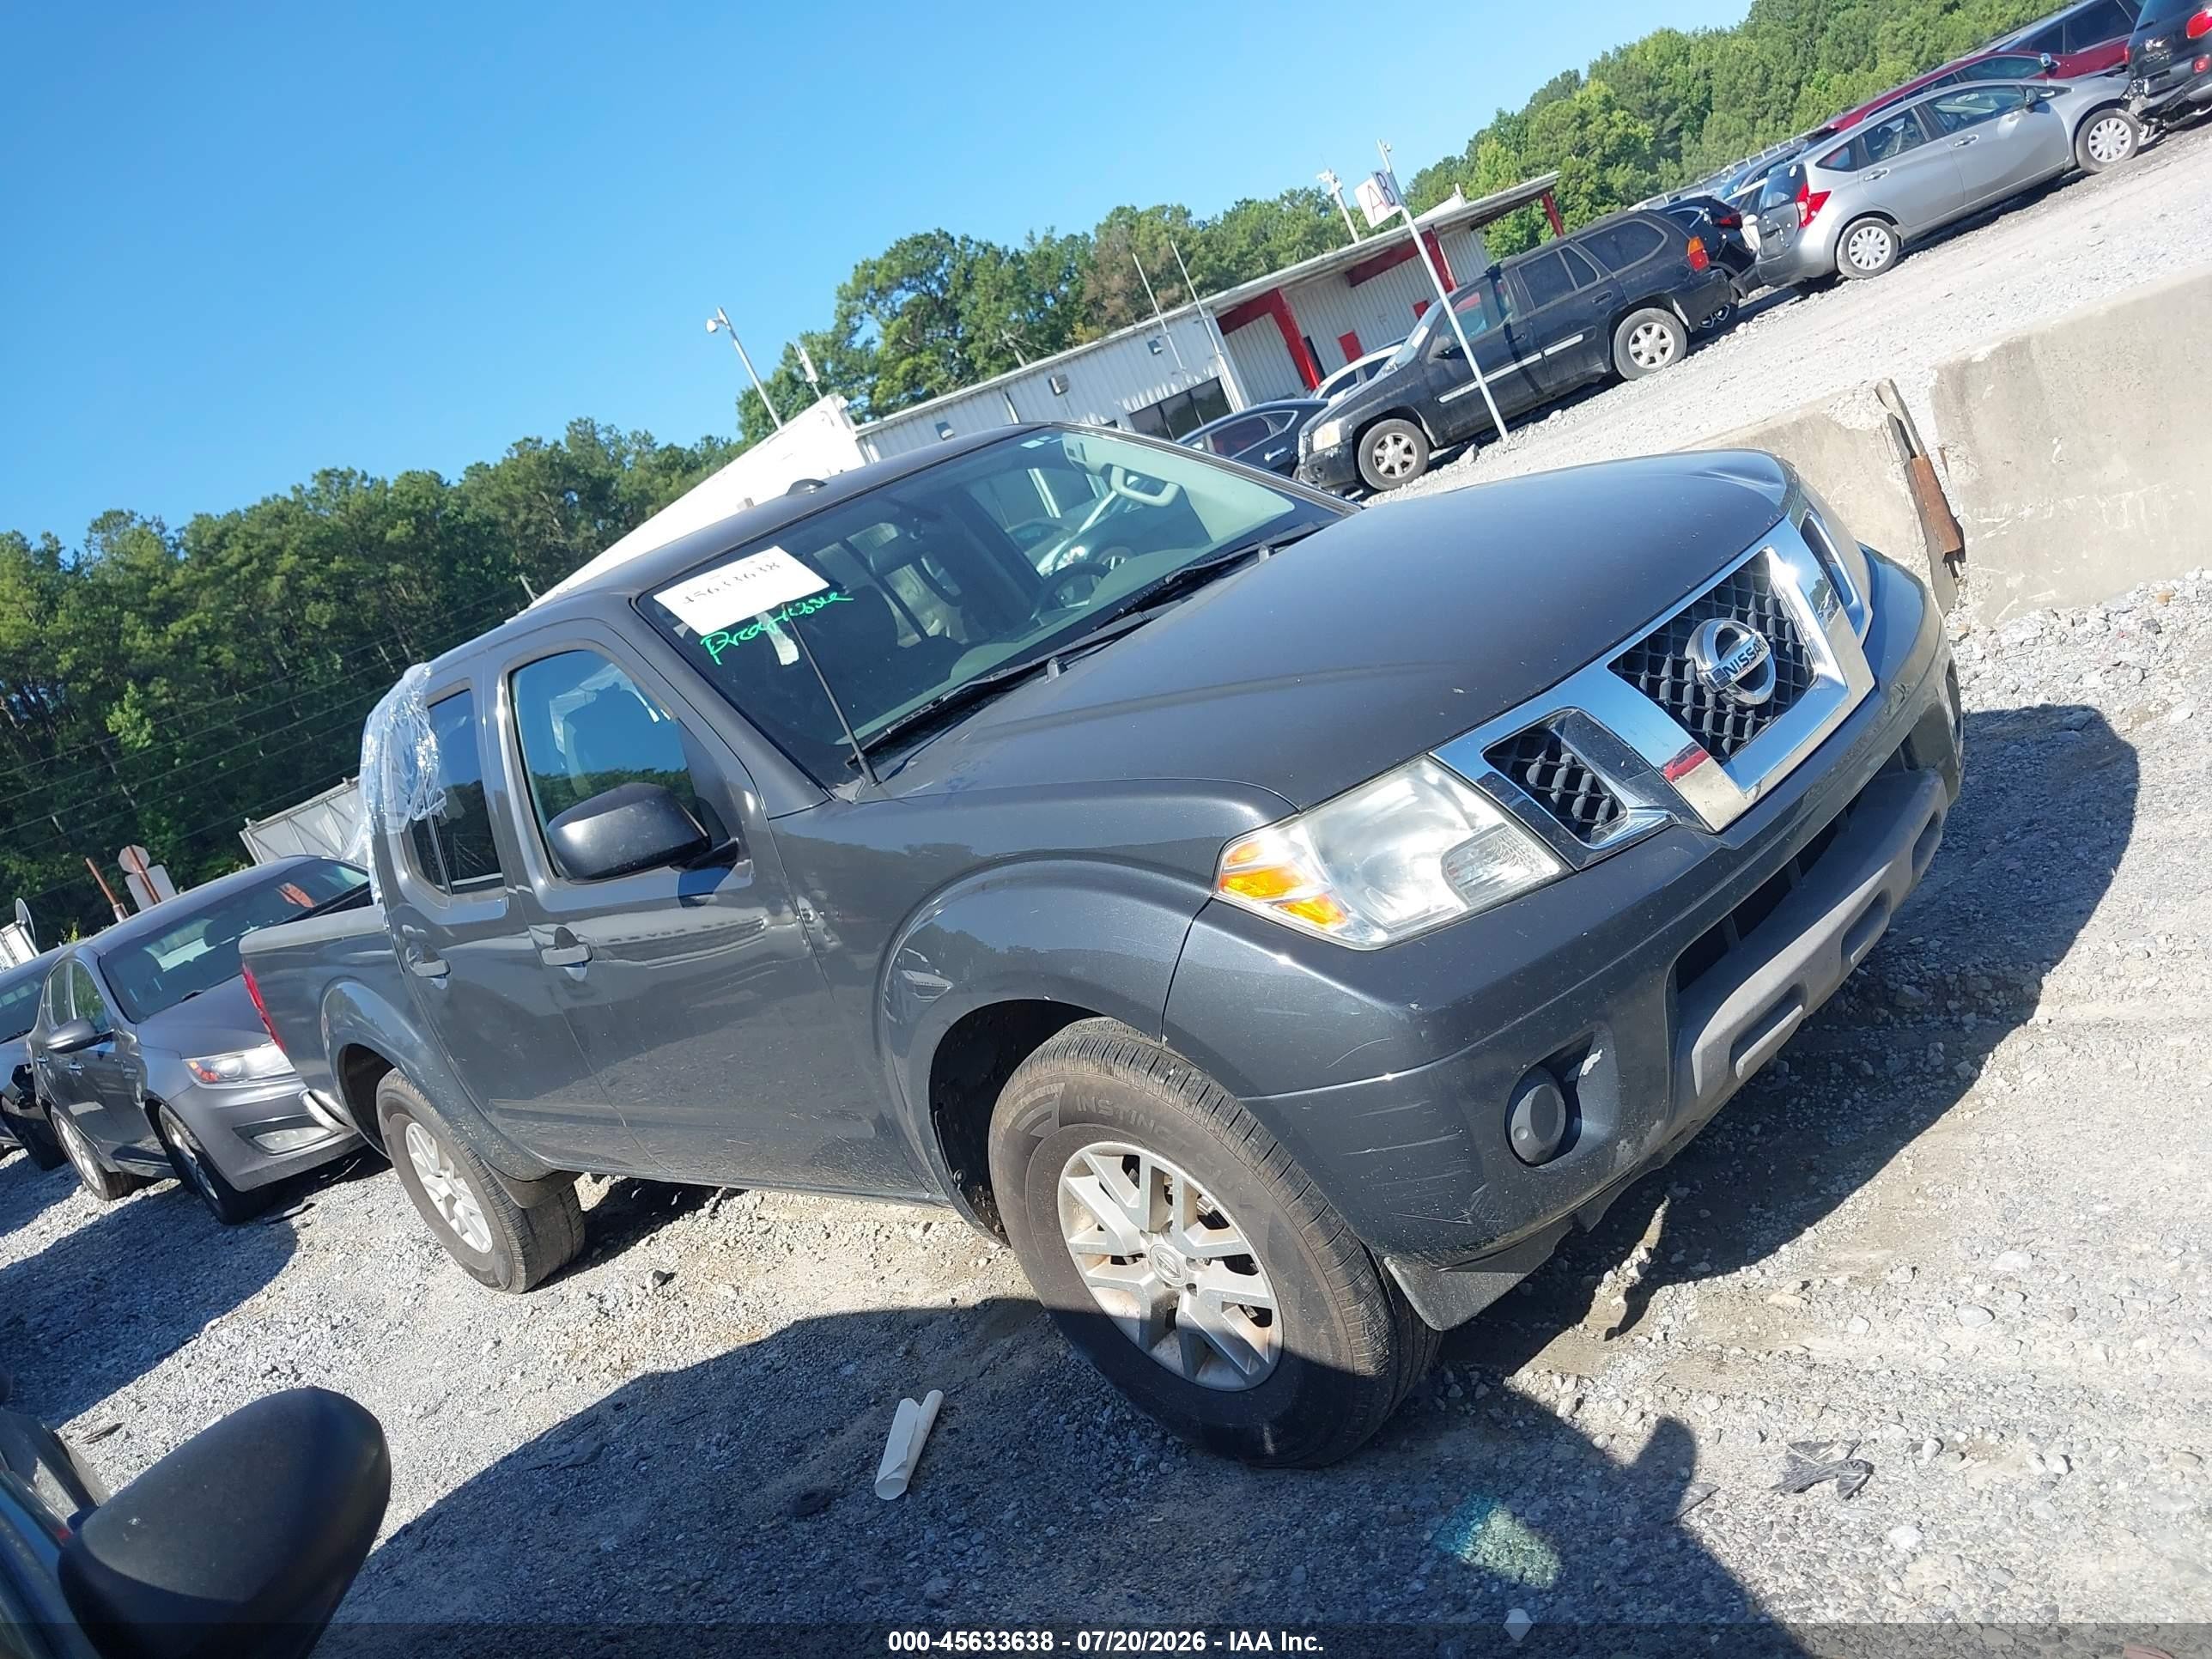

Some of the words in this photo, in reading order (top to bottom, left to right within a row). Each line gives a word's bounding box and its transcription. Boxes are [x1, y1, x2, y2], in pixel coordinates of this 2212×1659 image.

[1367, 184, 1391, 222] A
[1376, 172, 1395, 207] B
[1723, 637, 1771, 680] NISSAN
